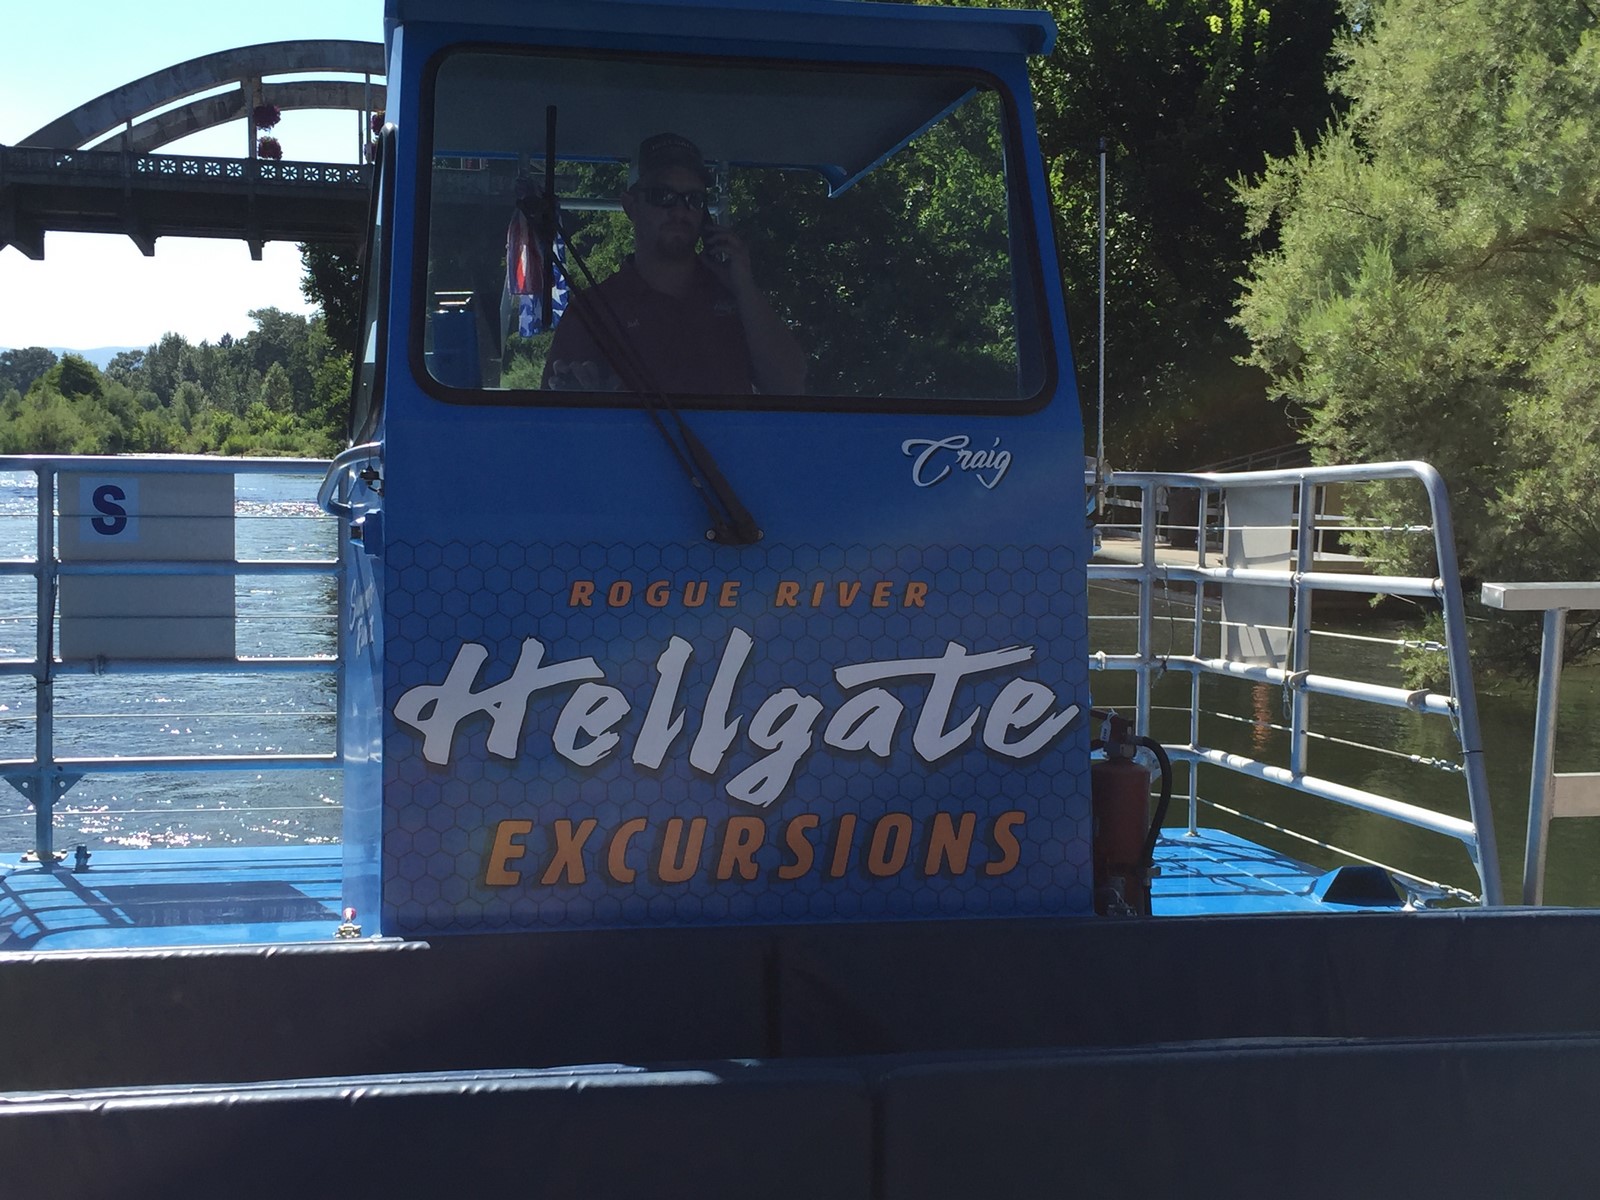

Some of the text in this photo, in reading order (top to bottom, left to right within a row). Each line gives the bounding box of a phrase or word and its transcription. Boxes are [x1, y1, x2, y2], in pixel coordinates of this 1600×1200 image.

[901, 435, 1011, 489] Craig
[91, 485, 127, 535] S
[569, 580, 929, 608] ROGUE RIVER
[394, 627, 1079, 807] Hellgate
[484, 811, 1028, 887] EXCURSIONS
